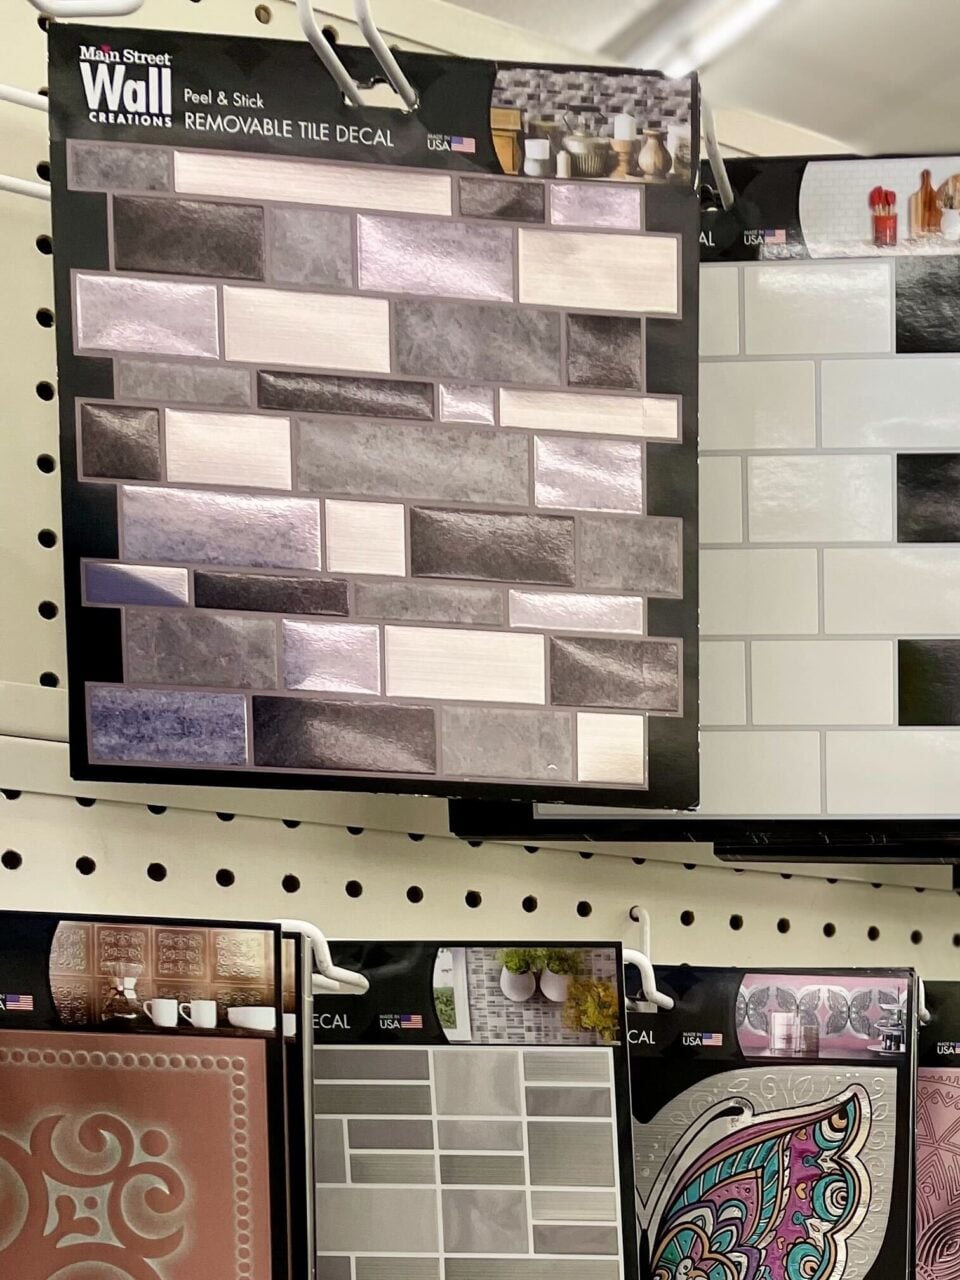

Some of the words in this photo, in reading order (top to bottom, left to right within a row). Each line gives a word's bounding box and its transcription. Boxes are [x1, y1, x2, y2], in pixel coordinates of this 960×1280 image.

[79, 44, 120, 63] Main
[123, 49, 171, 65] Street
[79, 61, 172, 115] Wall
[184, 88, 212, 104] Peel
[216, 91, 229, 106] &
[233, 92, 265, 109] Stick
[88, 111, 173, 128] CREATIONS
[184, 112, 293, 139] REMOVABLE
[298, 121, 330, 141] TILE
[336, 125, 395, 147] DECAL
[427, 139, 451, 152] USA
[743, 235, 764, 246] USA
[312, 1013, 351, 1029] ECAL
[379, 1019, 401, 1029] USA
[627, 1029, 656, 1045] CAL
[682, 1036, 702, 1046] USA
[936, 1046, 955, 1055] USA
